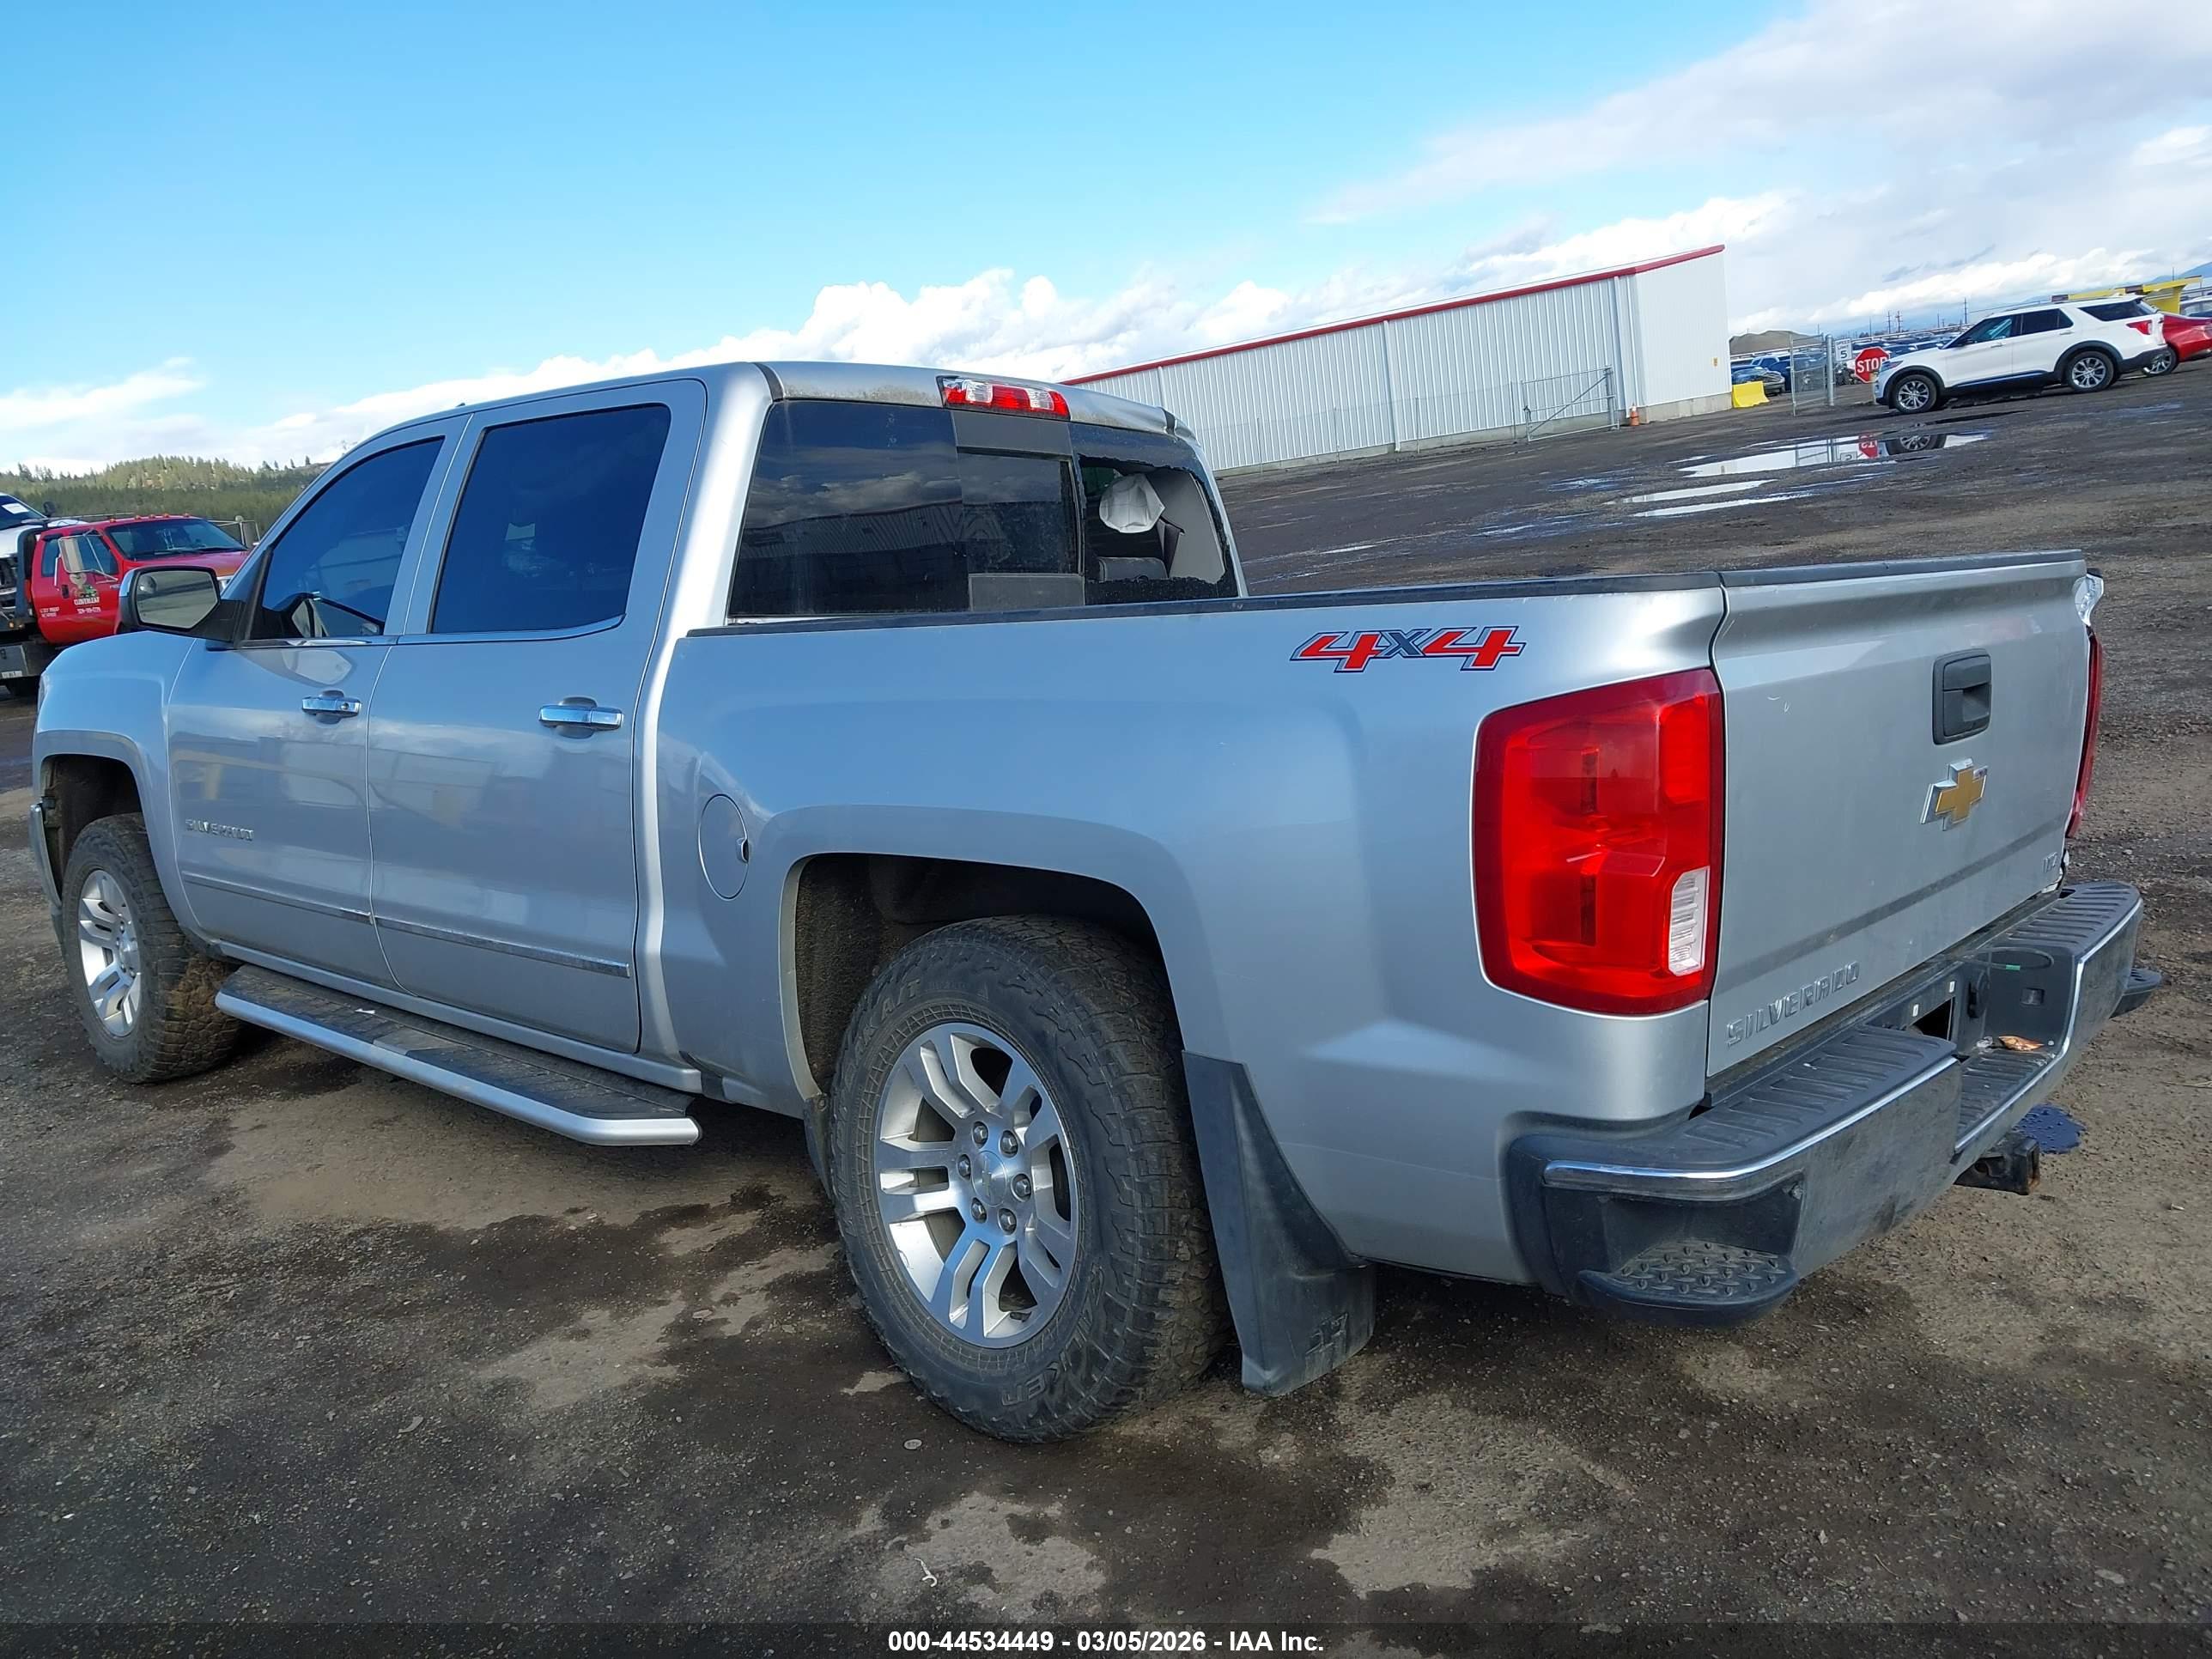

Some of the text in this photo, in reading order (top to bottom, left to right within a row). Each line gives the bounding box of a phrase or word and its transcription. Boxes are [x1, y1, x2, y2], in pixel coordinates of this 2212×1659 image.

[1840, 349, 1848, 359] 5
[185, 817, 254, 842] SILVERADO
[1726, 960, 1861, 1048] SILVERADO
